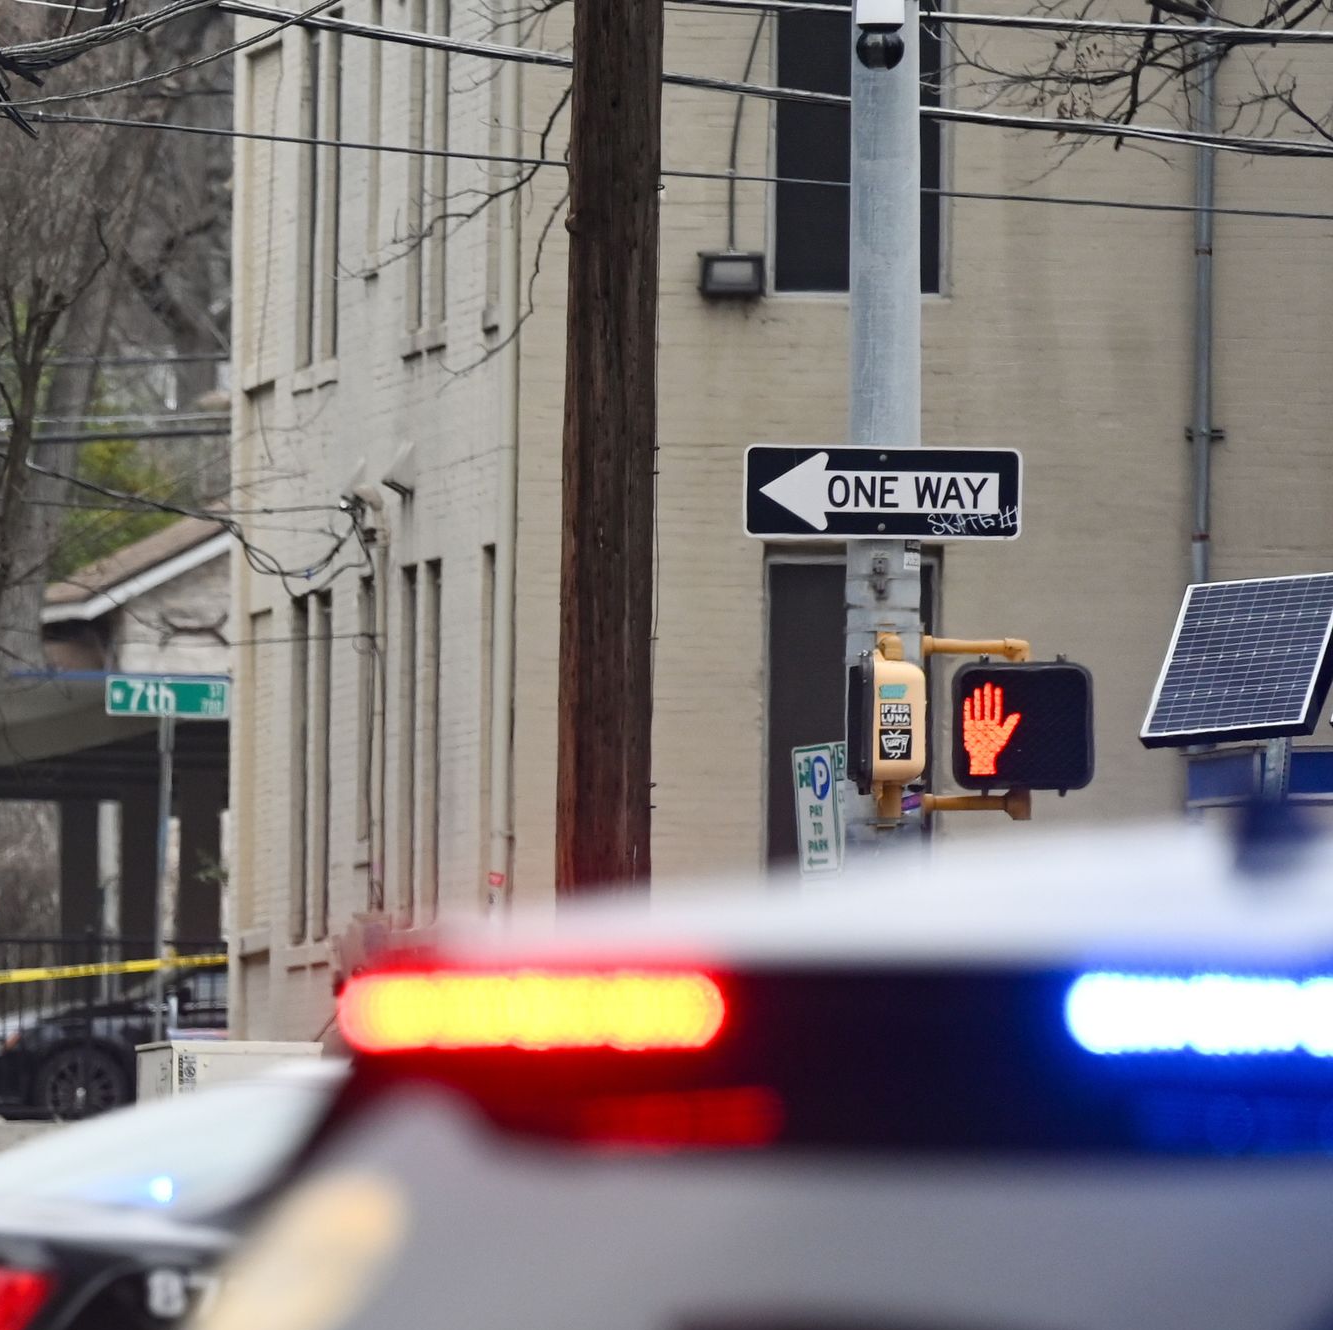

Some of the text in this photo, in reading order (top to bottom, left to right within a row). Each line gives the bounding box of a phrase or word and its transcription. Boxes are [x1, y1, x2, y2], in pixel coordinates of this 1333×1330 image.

[827, 475, 989, 510] ONE WAY
[127, 679, 176, 712] 7th
[881, 714, 910, 723] LUNA
[809, 804, 823, 817] PAY
[813, 822, 824, 835] TO
[808, 840, 829, 853] PARK
